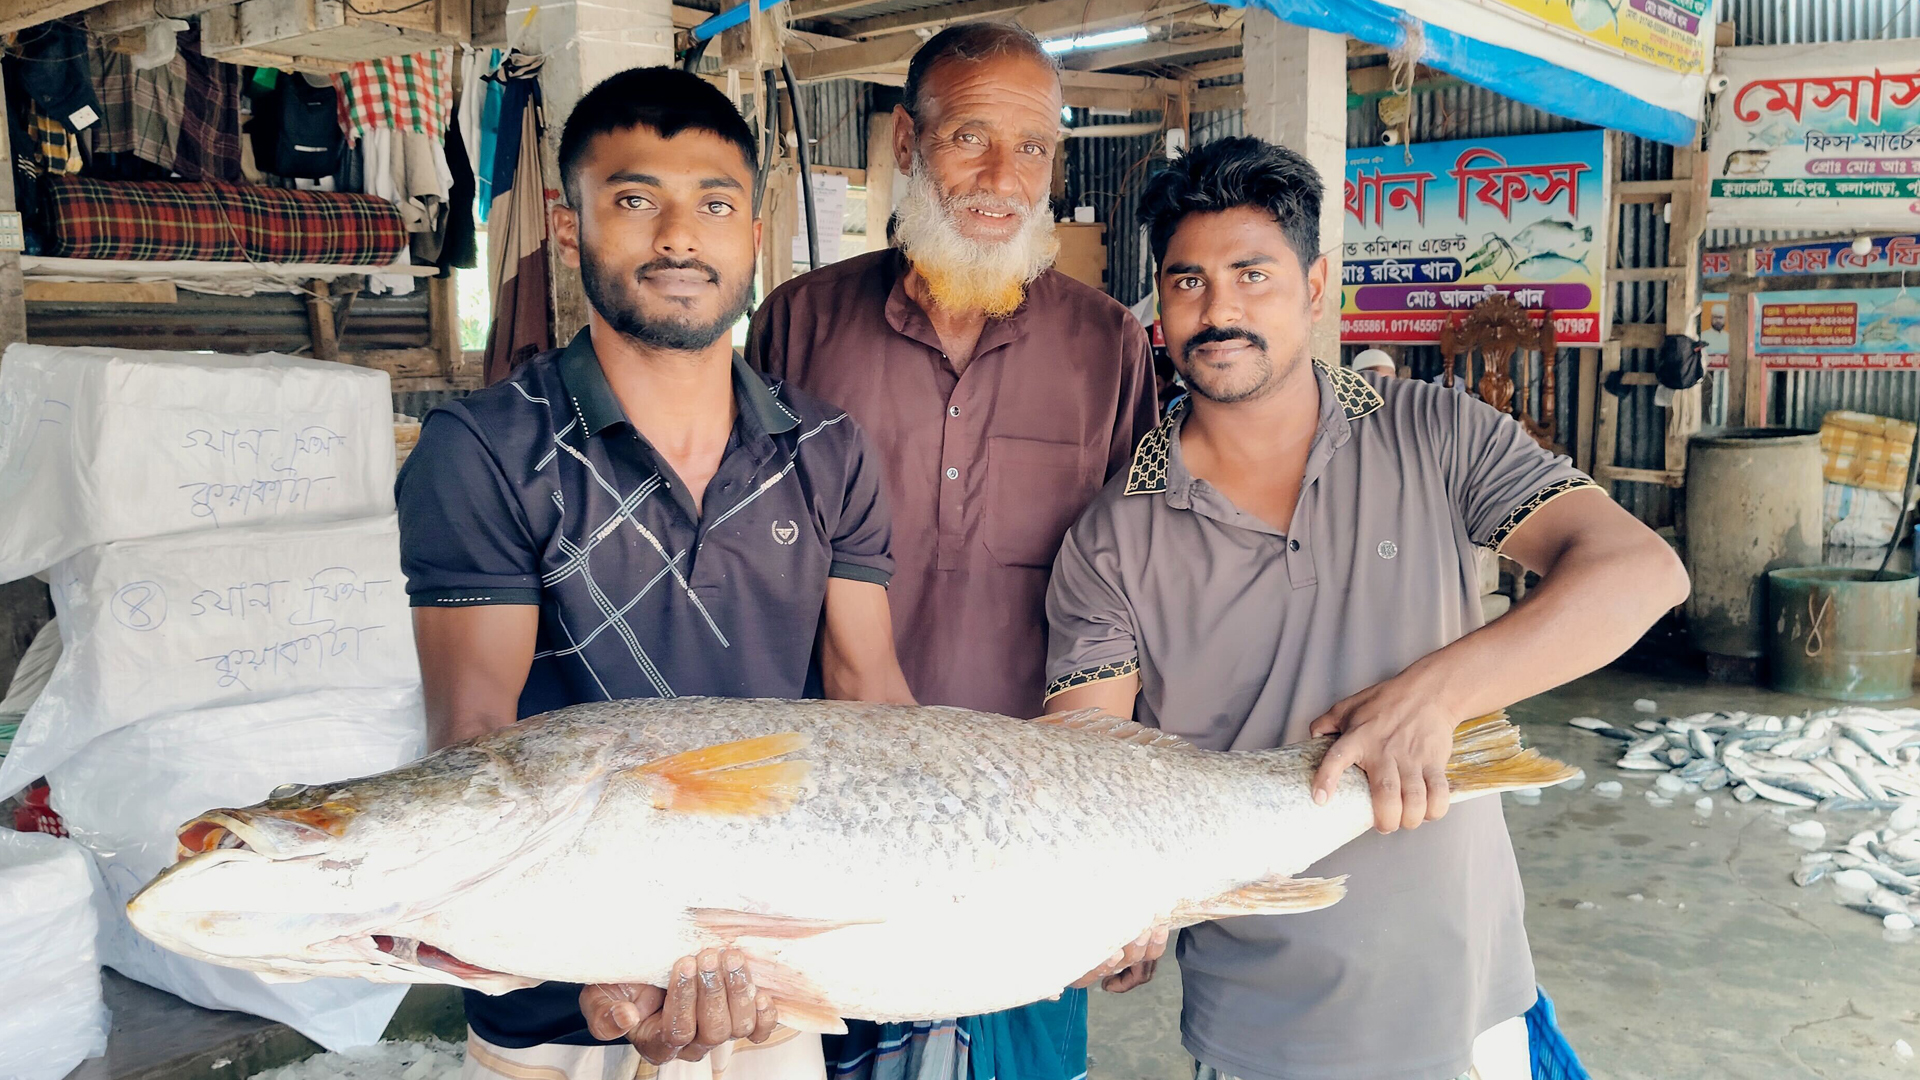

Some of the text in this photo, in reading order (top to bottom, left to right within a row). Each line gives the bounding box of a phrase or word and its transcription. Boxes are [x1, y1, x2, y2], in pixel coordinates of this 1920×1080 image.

[1803, 129, 1856, 153] ফিস
[1846, 160, 1876, 174] মোঃ
[1446, 147, 1592, 224] ফিস
[1362, 235, 1414, 257] কমিশন
[1418, 233, 1468, 254] এজেন্ট
[1369, 257, 1417, 283] রহিম
[1420, 260, 1457, 281] খান
[1406, 289, 1437, 308] মোঃ
[636, 523, 663, 552] FASHION
[677, 574, 697, 600] FASON
